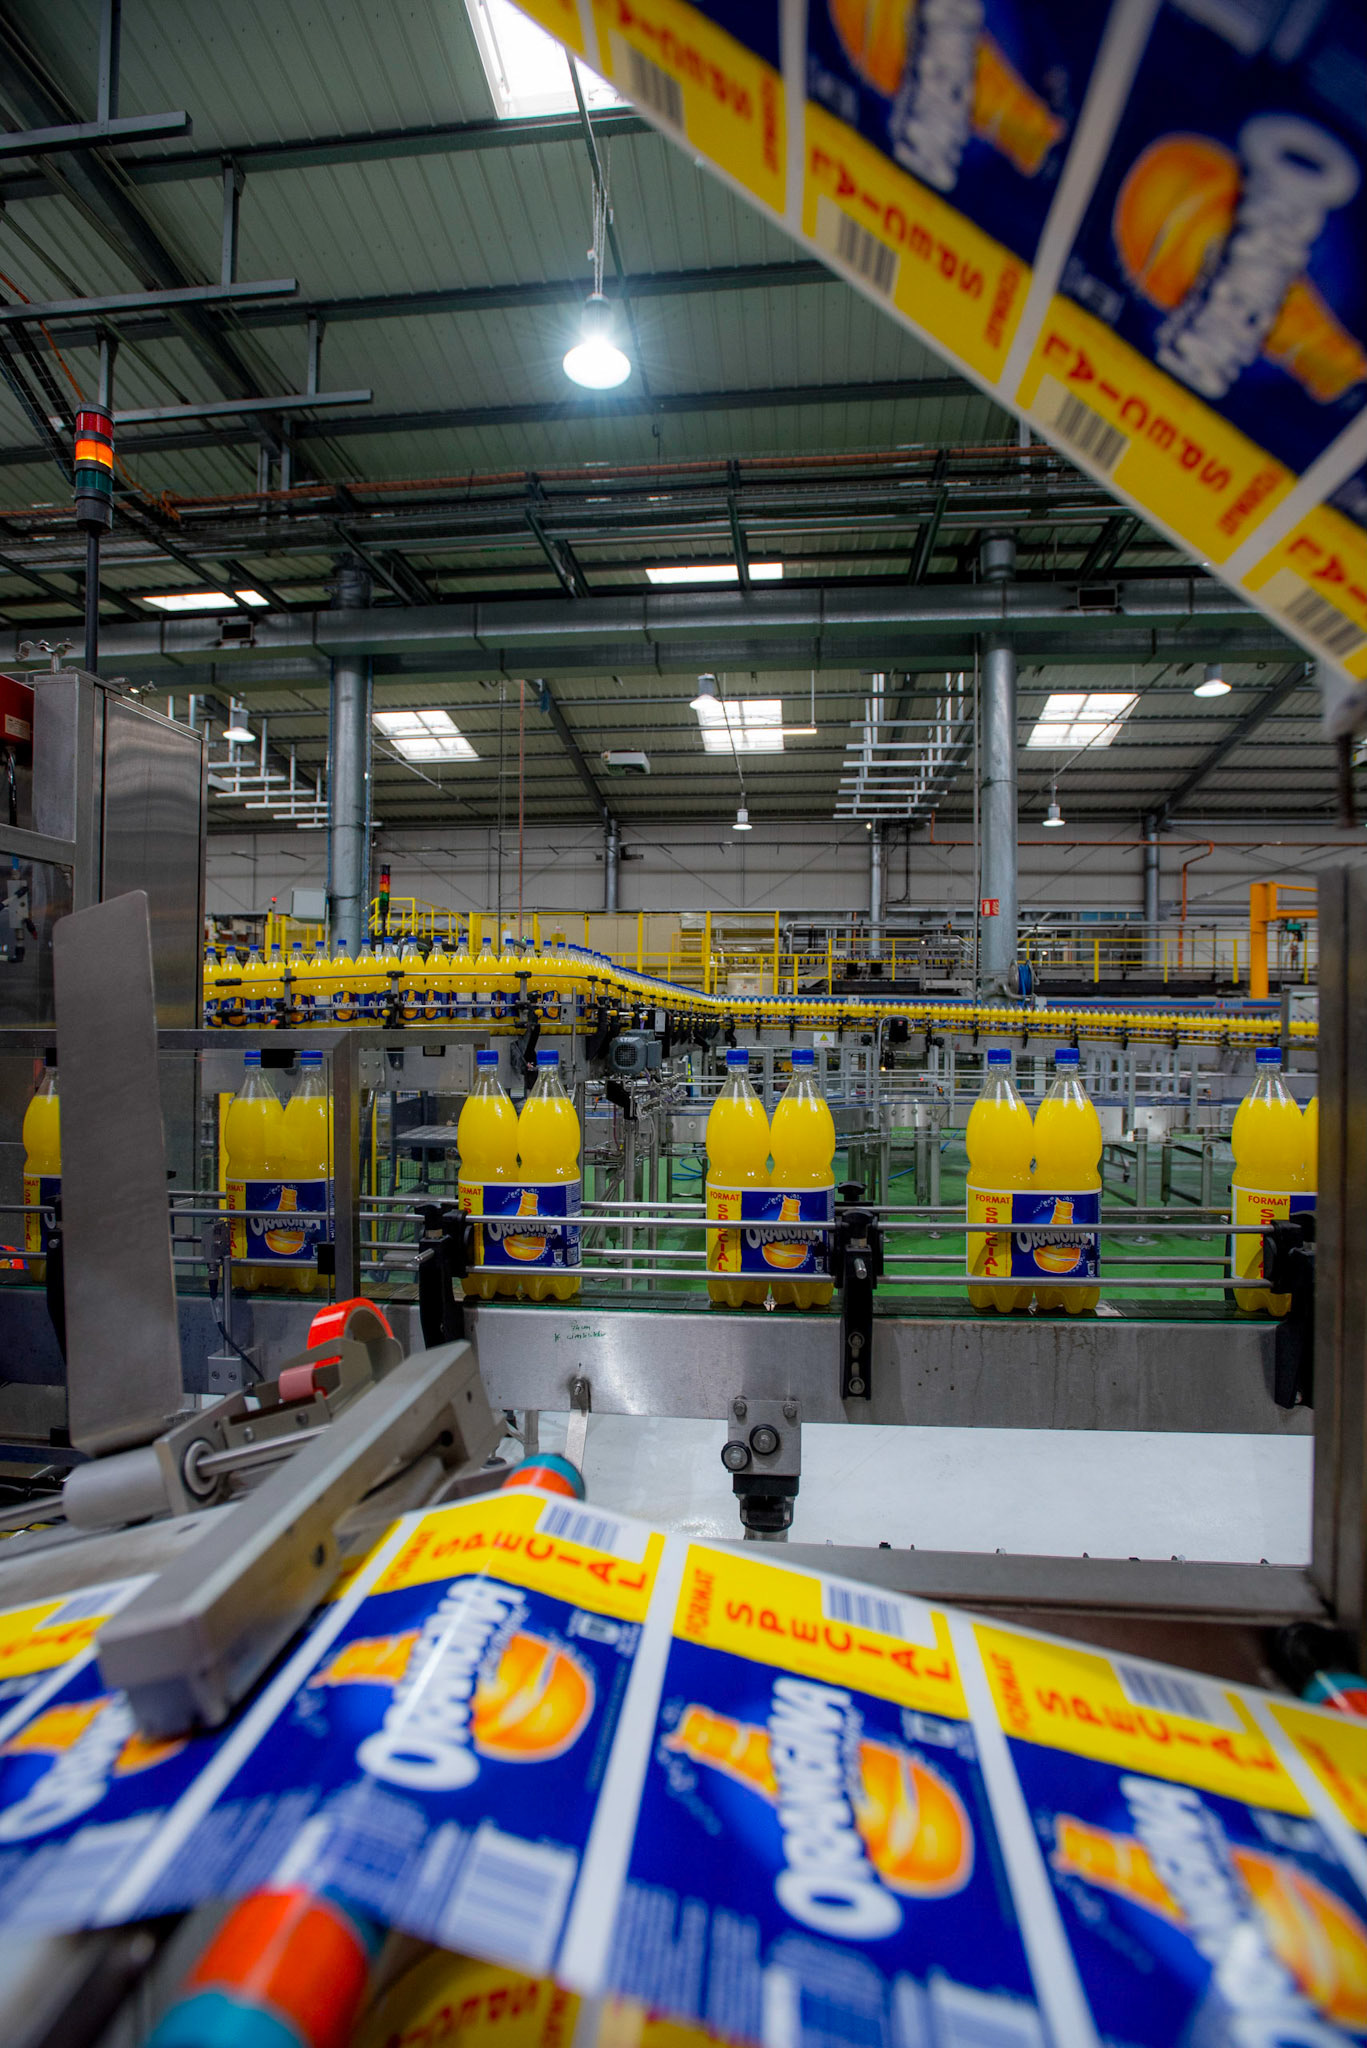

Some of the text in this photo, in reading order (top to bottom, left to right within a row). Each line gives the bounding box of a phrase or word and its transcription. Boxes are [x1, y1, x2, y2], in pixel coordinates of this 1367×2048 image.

[459, 1186, 481, 1196] ORMAT
[710, 1191, 740, 1201] FORMAT
[975, 1193, 1011, 1204] FORMAT
[1248, 1195, 1288, 1206] FORMAT
[431, 1531, 647, 1591] SPECIAL
[725, 1600, 951, 1682] SPECIAL
